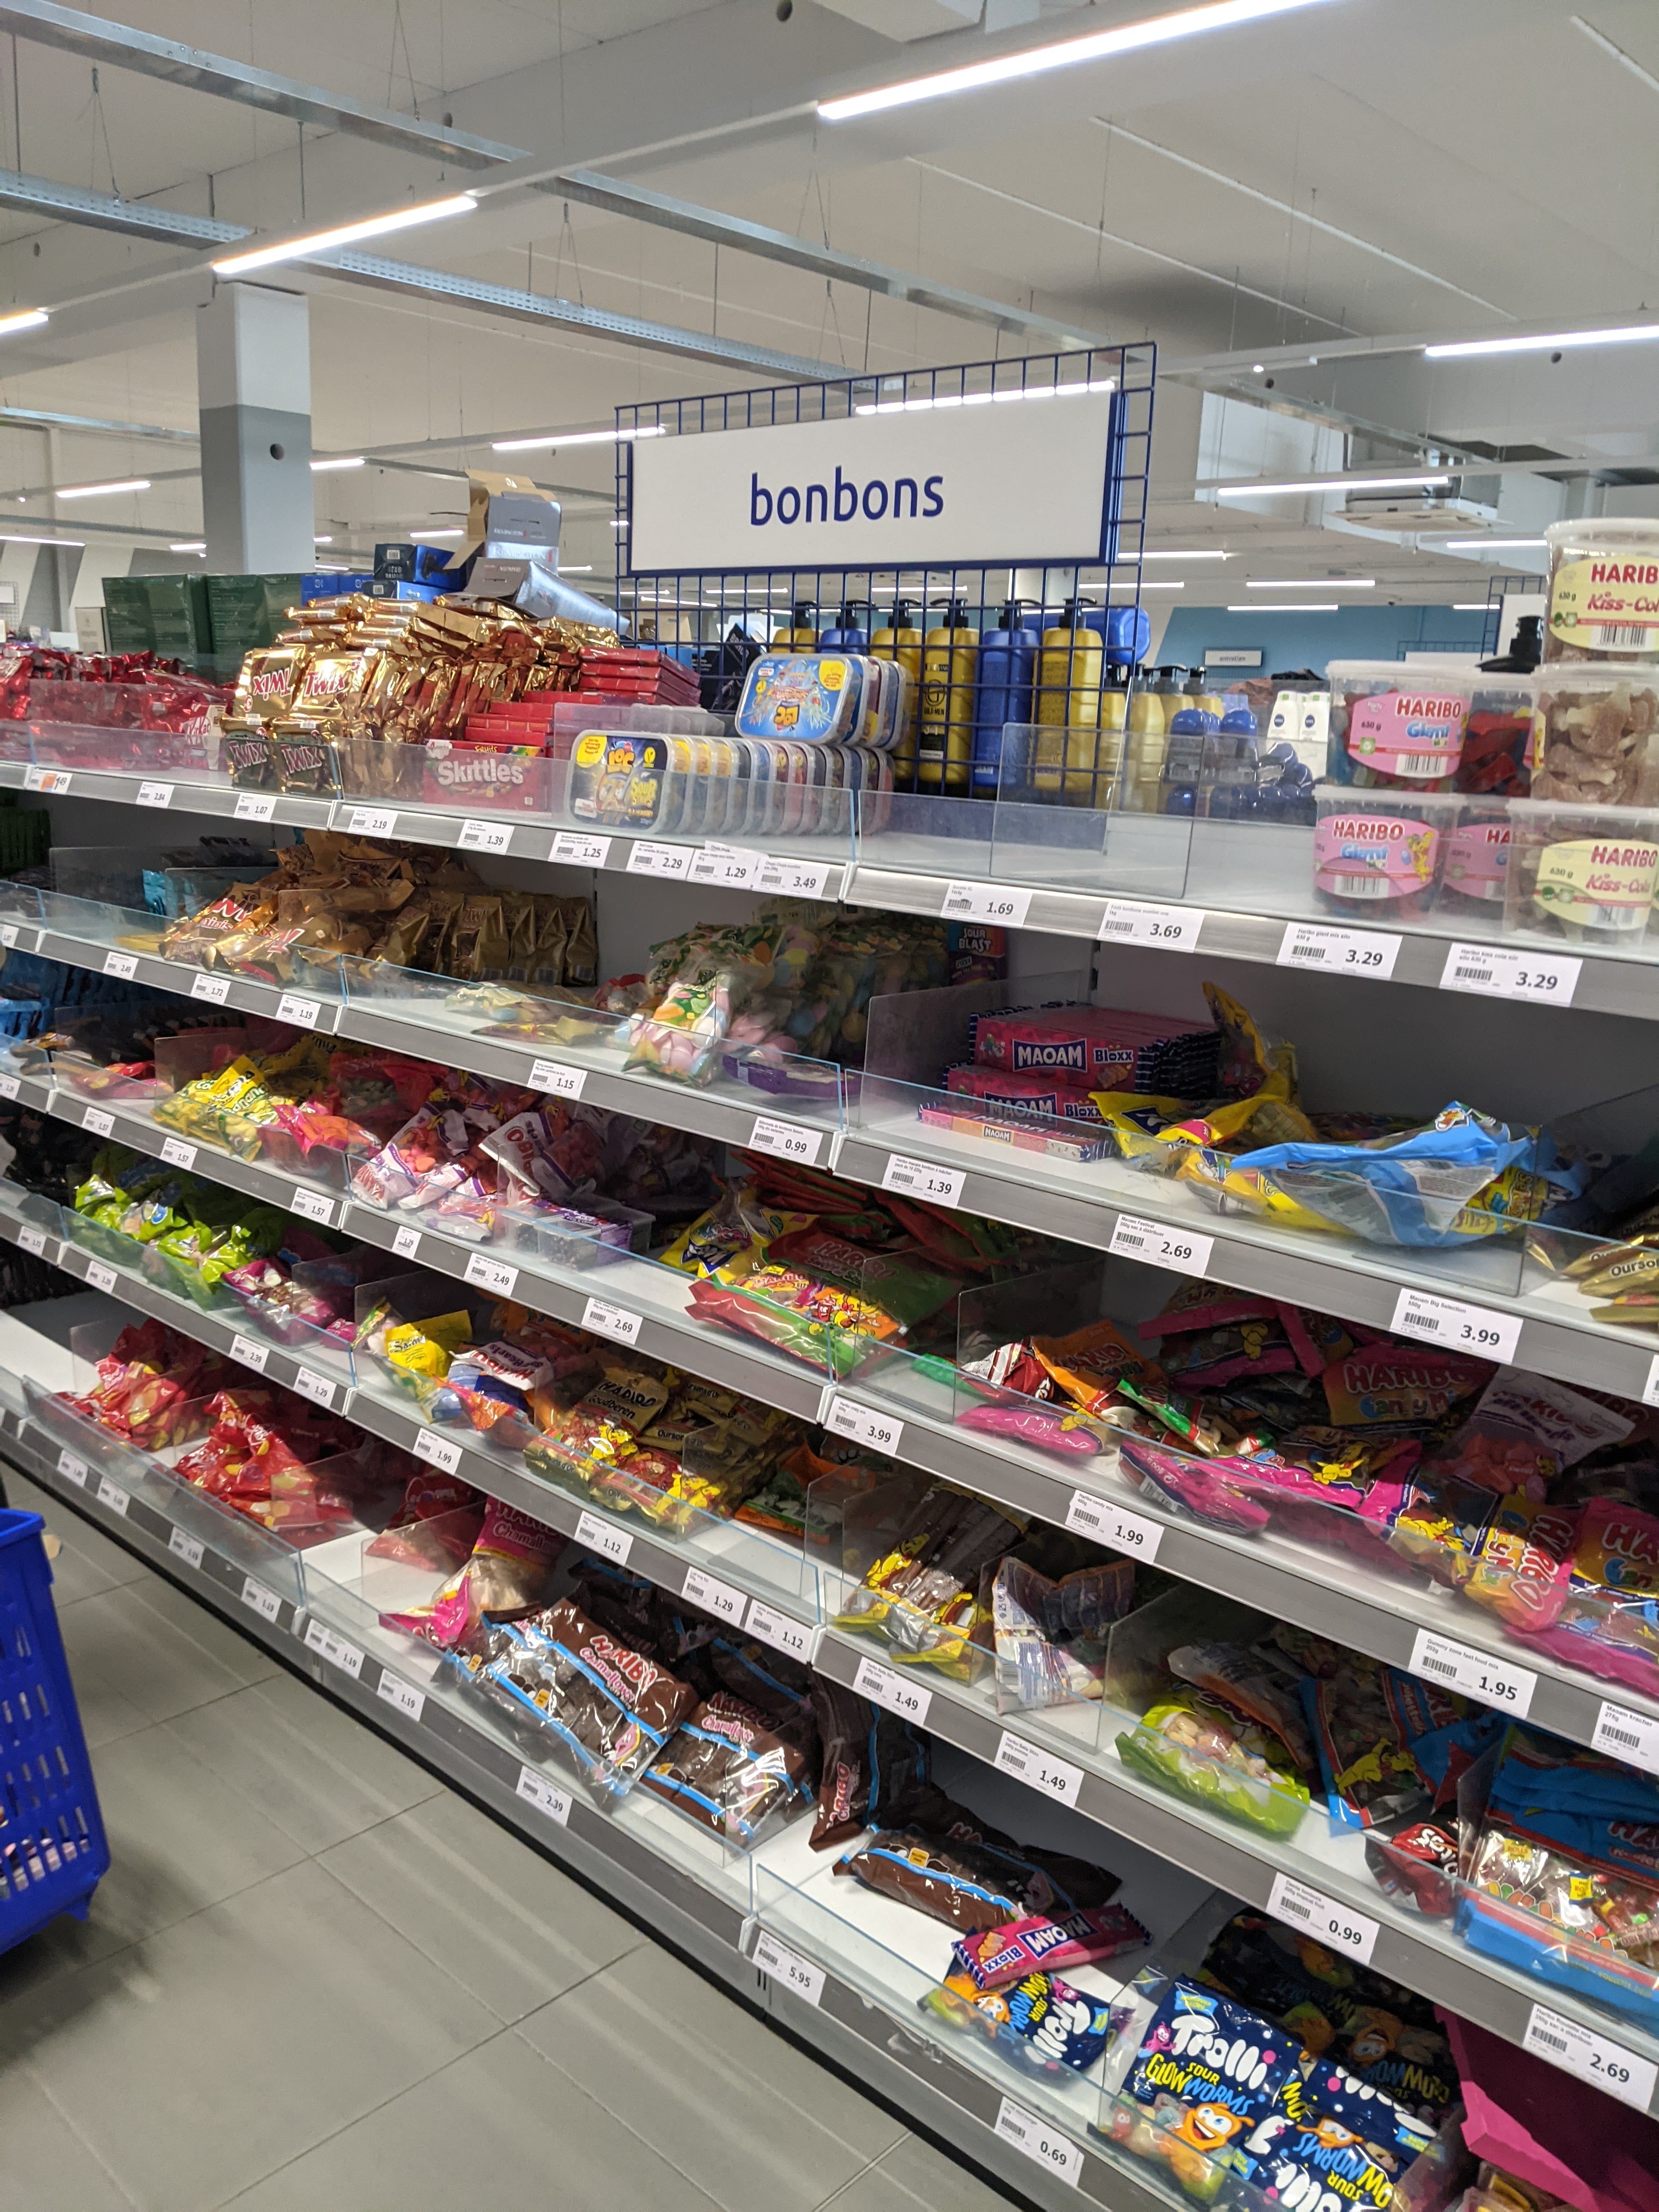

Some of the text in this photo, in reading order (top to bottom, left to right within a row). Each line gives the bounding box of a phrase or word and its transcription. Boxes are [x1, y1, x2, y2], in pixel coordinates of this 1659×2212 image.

[751, 466, 944, 526] bonbons
[1591, 563, 1658, 584] HARIB
[1587, 591, 1659, 612] Kiss-Col
[252, 668, 291, 701] Twix
[304, 671, 348, 697] Twix
[1397, 696, 1462, 719] HARIBO
[229, 741, 267, 769] Twix
[281, 744, 322, 774] Twix
[438, 759, 523, 785] Skittles
[255, 805, 268, 814] 1.07
[372, 820, 387, 829] 2.19
[1334, 820, 1404, 841] HARIBO
[487, 835, 504, 845] 1.39
[583, 848, 602, 858] 1.25
[1591, 845, 1658, 867] HARIBO
[663, 857, 682, 868] 2.29
[725, 866, 747, 878] 1.29
[793, 877, 816, 888] 3.49
[987, 901, 1014, 915] 1.69
[1150, 923, 1182, 938] 3.69
[958, 939, 992, 952] BLAST
[1346, 949, 1383, 966] 3.29
[1516, 971, 1558, 989] 3.29
[300, 1009, 313, 1019] 1.19
[1018, 1045, 1081, 1067] MAOAM
[1094, 1048, 1133, 1063] Bloxx
[557, 1077, 575, 1089] 1.15
[985, 1127, 1009, 1141] MAOAM
[785, 1139, 807, 1153] 0.99
[927, 1179, 952, 1194] 1.39
[312, 1205, 325, 1216] 1.57
[1121, 1216, 1155, 1229] Maoam Festival
[1161, 1241, 1192, 1259] 2.69
[1611, 1259, 1658, 1278] Ourso
[494, 1273, 510, 1285] 2.49
[1410, 1295, 1429, 1304] Maoam
[1430, 1300, 1440, 1308] Big
[615, 1319, 633, 1333] 2.69
[1460, 1324, 1501, 1346] 3.99
[250, 1352, 262, 1363] 2.39
[315, 1386, 328, 1397] 1.29
[868, 1426, 891, 1442] 3.99
[437, 1451, 452, 1464] 1.99
[1079, 1493, 1092, 1502] Haribo
[1093, 1499, 1105, 1509] candy
[1115, 1525, 1143, 1545] 1.99
[603, 1538, 621, 1554] 1.12
[714, 1595, 733, 1612] 1.29
[782, 1631, 803, 1650] 1.12
[1426, 1645, 1439, 1654] 202g
[1427, 1638, 1498, 1670] Gummy zone fast food mix
[590, 1635, 658, 1695] HARIBO
[580, 1647, 636, 1703] Chamallows
[1479, 1675, 1517, 1700] 1.95
[401, 1694, 415, 1708] 1.19
[895, 1691, 918, 1711] 1.49
[1606, 1705, 1653, 1728] Maoam kracher
[1040, 1770, 1066, 1790] 1.49
[546, 1795, 564, 1812] 2.39
[1025, 1916, 1091, 1953] MAOAM
[1329, 1919, 1362, 1945] 0.99
[984, 1947, 1024, 1972] Bloxx
[789, 1965, 812, 1988] 5.95
[1024, 1996, 1091, 2065] Trolli
[1172, 2015, 1267, 2089] Trolli
[1186, 2062, 1220, 2086] SOUR
[1590, 2052, 1630, 2083] 2.69
[1040, 2141, 1067, 2165] 0.69
[1293, 2133, 1394, 2208] OWWORMS
[1327, 2170, 1364, 2201] SOUR
